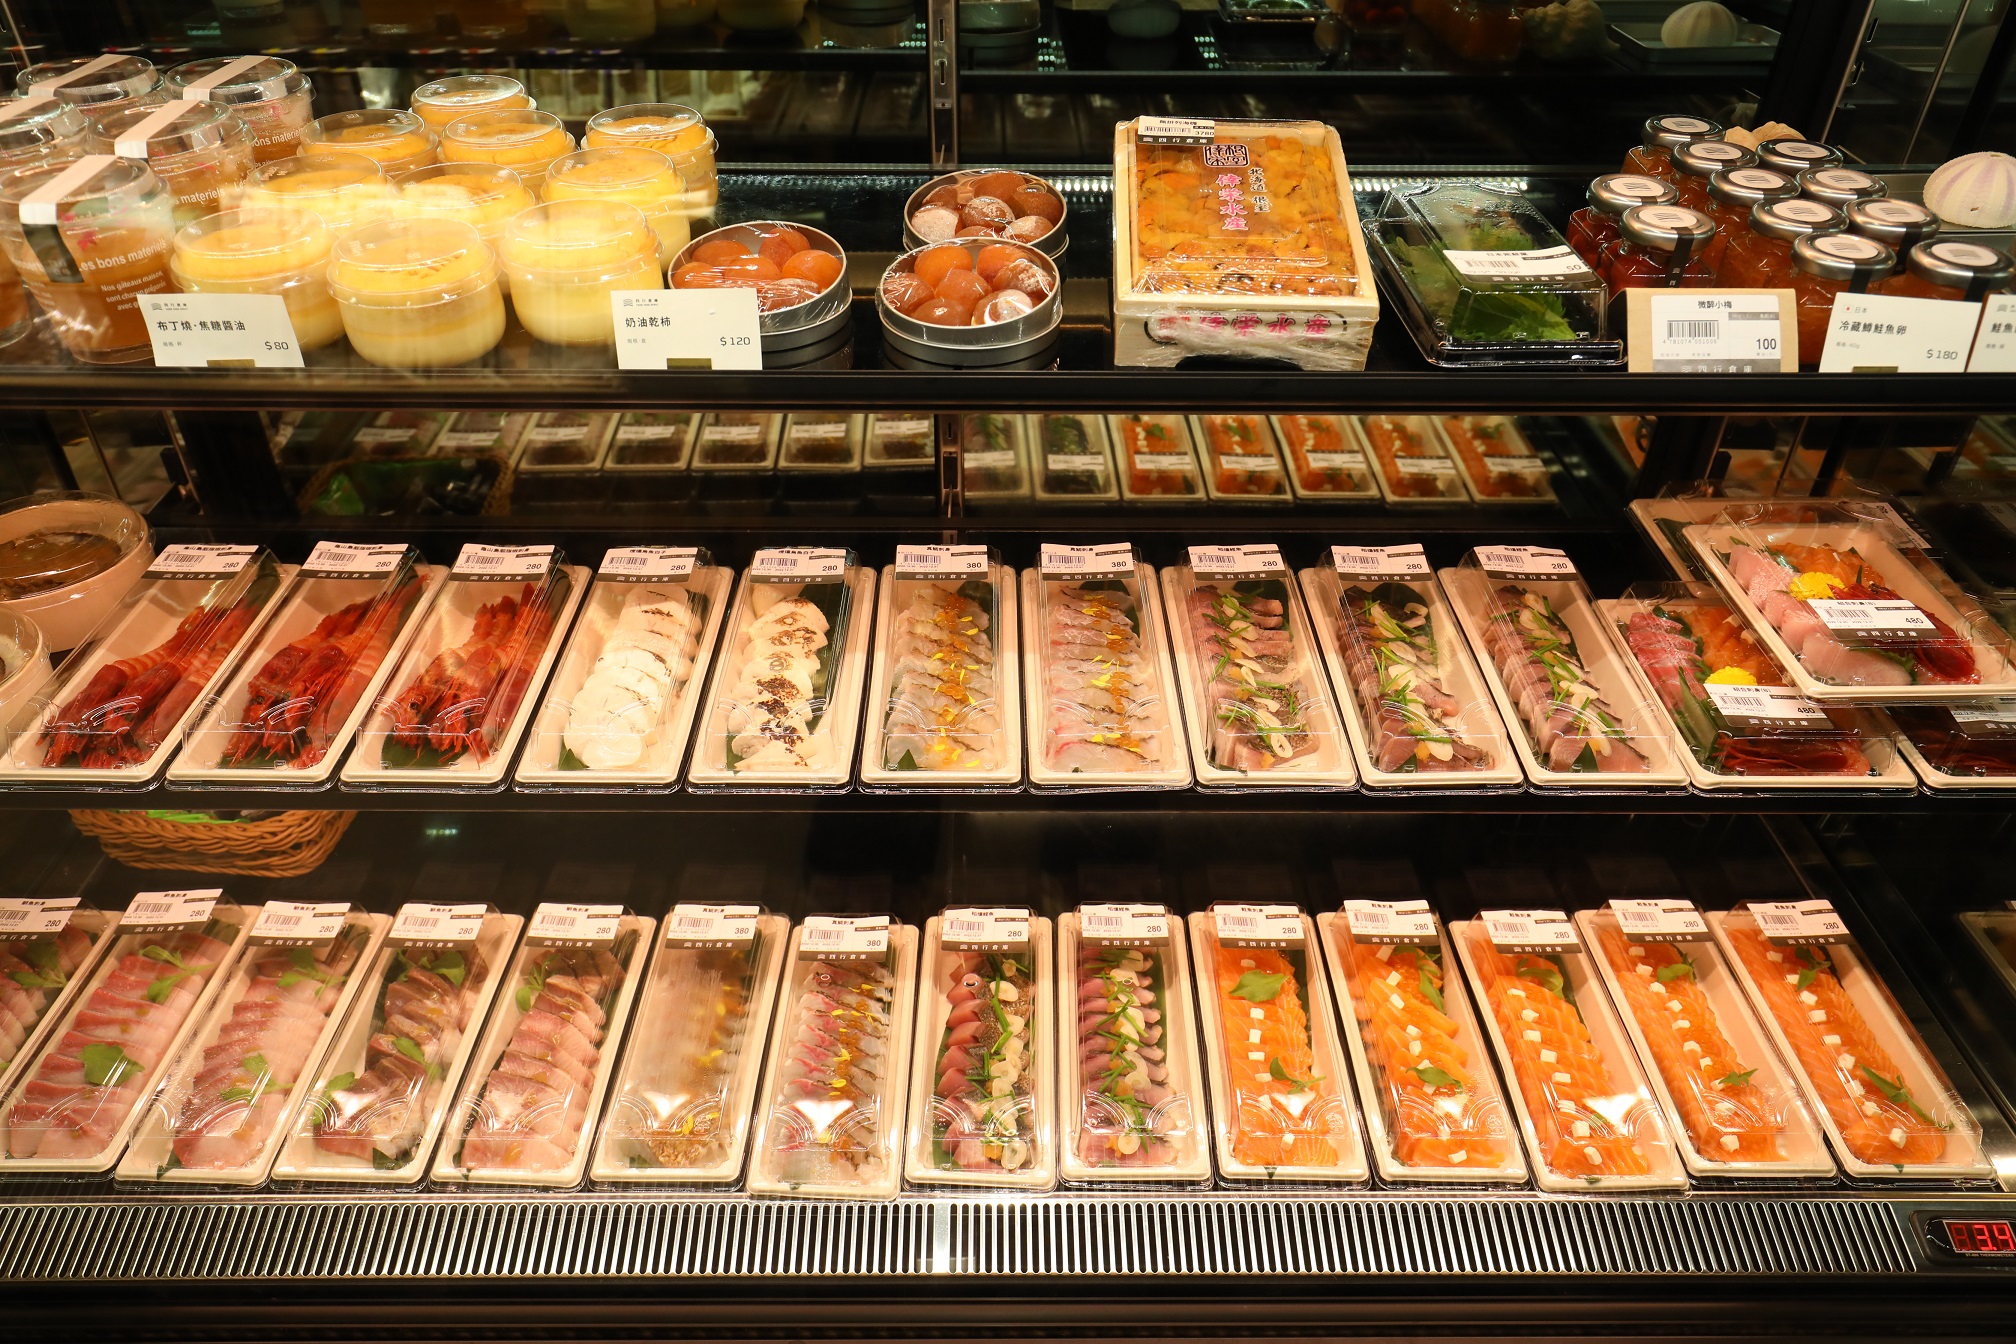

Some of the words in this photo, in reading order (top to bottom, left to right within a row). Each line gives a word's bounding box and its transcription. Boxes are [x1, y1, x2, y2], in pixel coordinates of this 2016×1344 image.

[1248, 167, 1268, 192] 北海道
[78, 260, 96, 272] es
[96, 256, 126, 268] bons
[625, 316, 671, 328] 奶油乾柿
[1990, 322, 2016, 334] 鮭魚
[1756, 338, 1778, 350] 100
[44, 920, 62, 928] 280
[734, 927, 750, 935] 380
